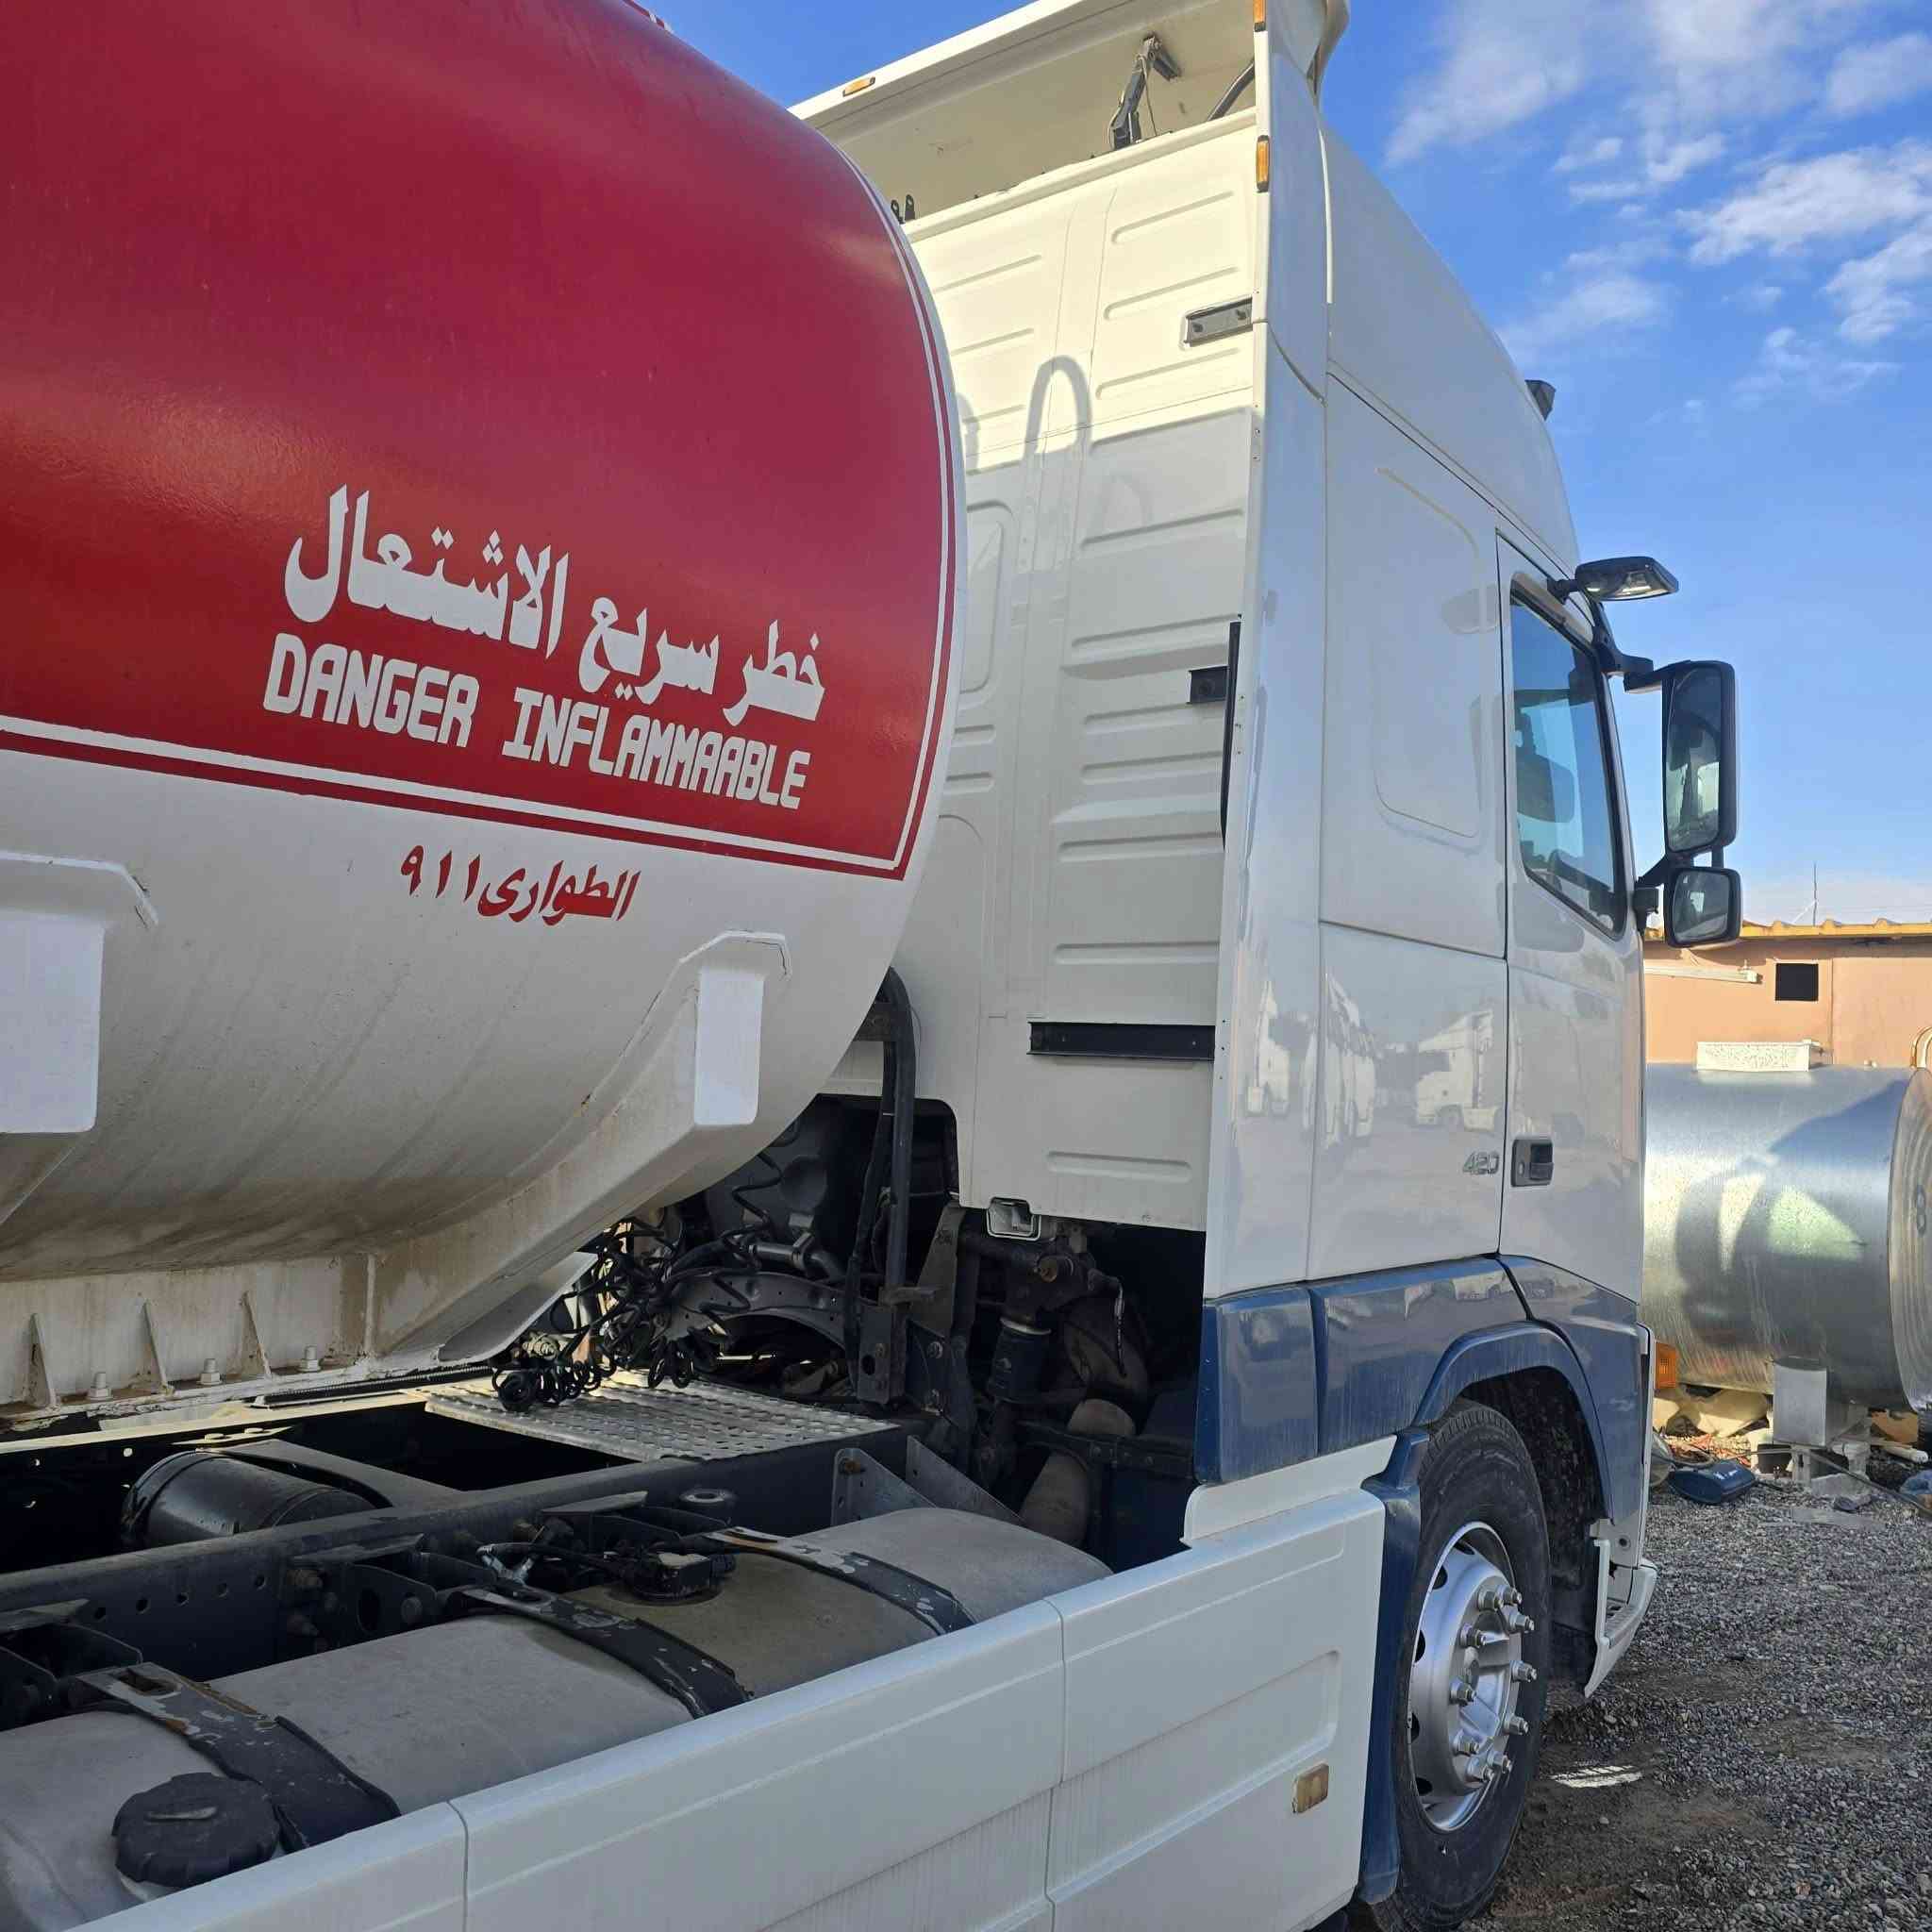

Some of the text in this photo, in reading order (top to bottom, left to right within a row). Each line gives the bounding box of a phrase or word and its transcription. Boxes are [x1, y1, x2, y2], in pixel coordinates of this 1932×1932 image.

[284, 483, 824, 726] خطر سريع الاشتعال
[263, 633, 811, 809] DANGER INFLAMMAABLE
